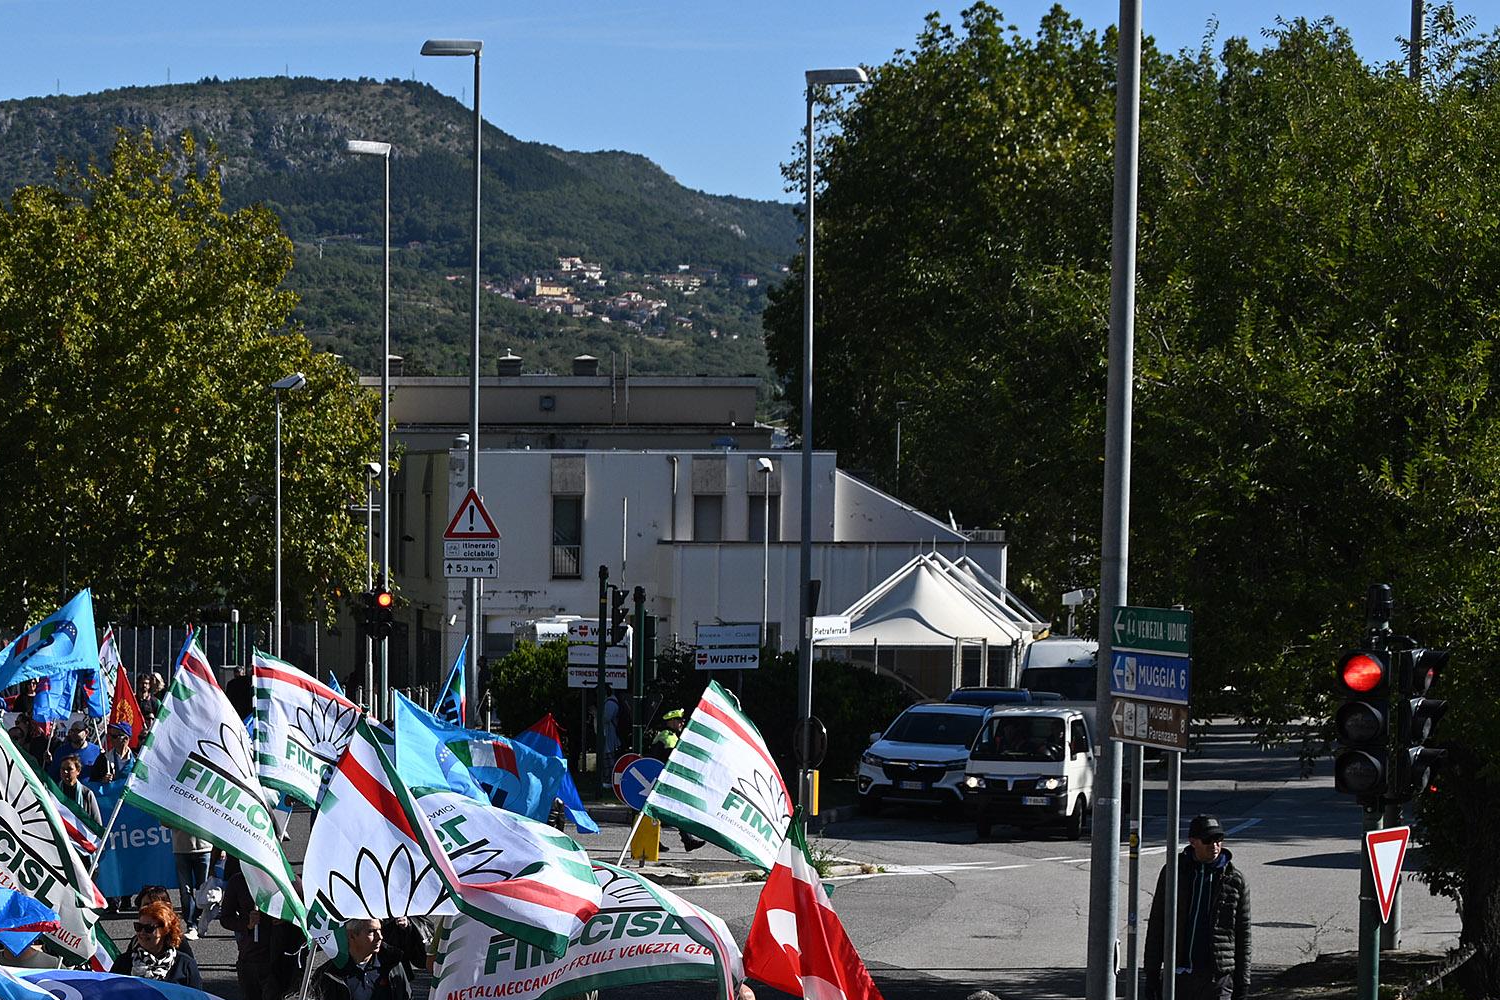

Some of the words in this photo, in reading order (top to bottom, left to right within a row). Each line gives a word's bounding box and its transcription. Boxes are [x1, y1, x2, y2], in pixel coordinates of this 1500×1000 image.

[814, 627, 848, 635] Pietraferrata
[1137, 620, 1164, 640] VENEZIA
[1167, 622, 1188, 642] UDINE
[1138, 665, 1176, 689] MUGGIA
[1180, 669, 1187, 690] 6
[1148, 705, 1174, 722] MUGGIA
[1180, 719, 1186, 734] 8
[1148, 726, 1179, 744] Parenzana
[285, 740, 334, 785] FIM-C
[169, 784, 221, 816] FEDERAZIONE
[220, 812, 252, 836] ITALIANA
[175, 758, 276, 842] FIM-C
[721, 791, 778, 850] FIM-
[109, 824, 175, 850] riest
[52, 922, 82, 949] IULIA
[567, 947, 617, 973] FRIULI
[618, 941, 681, 960] VENEZIA
[684, 942, 713, 957] GIU
